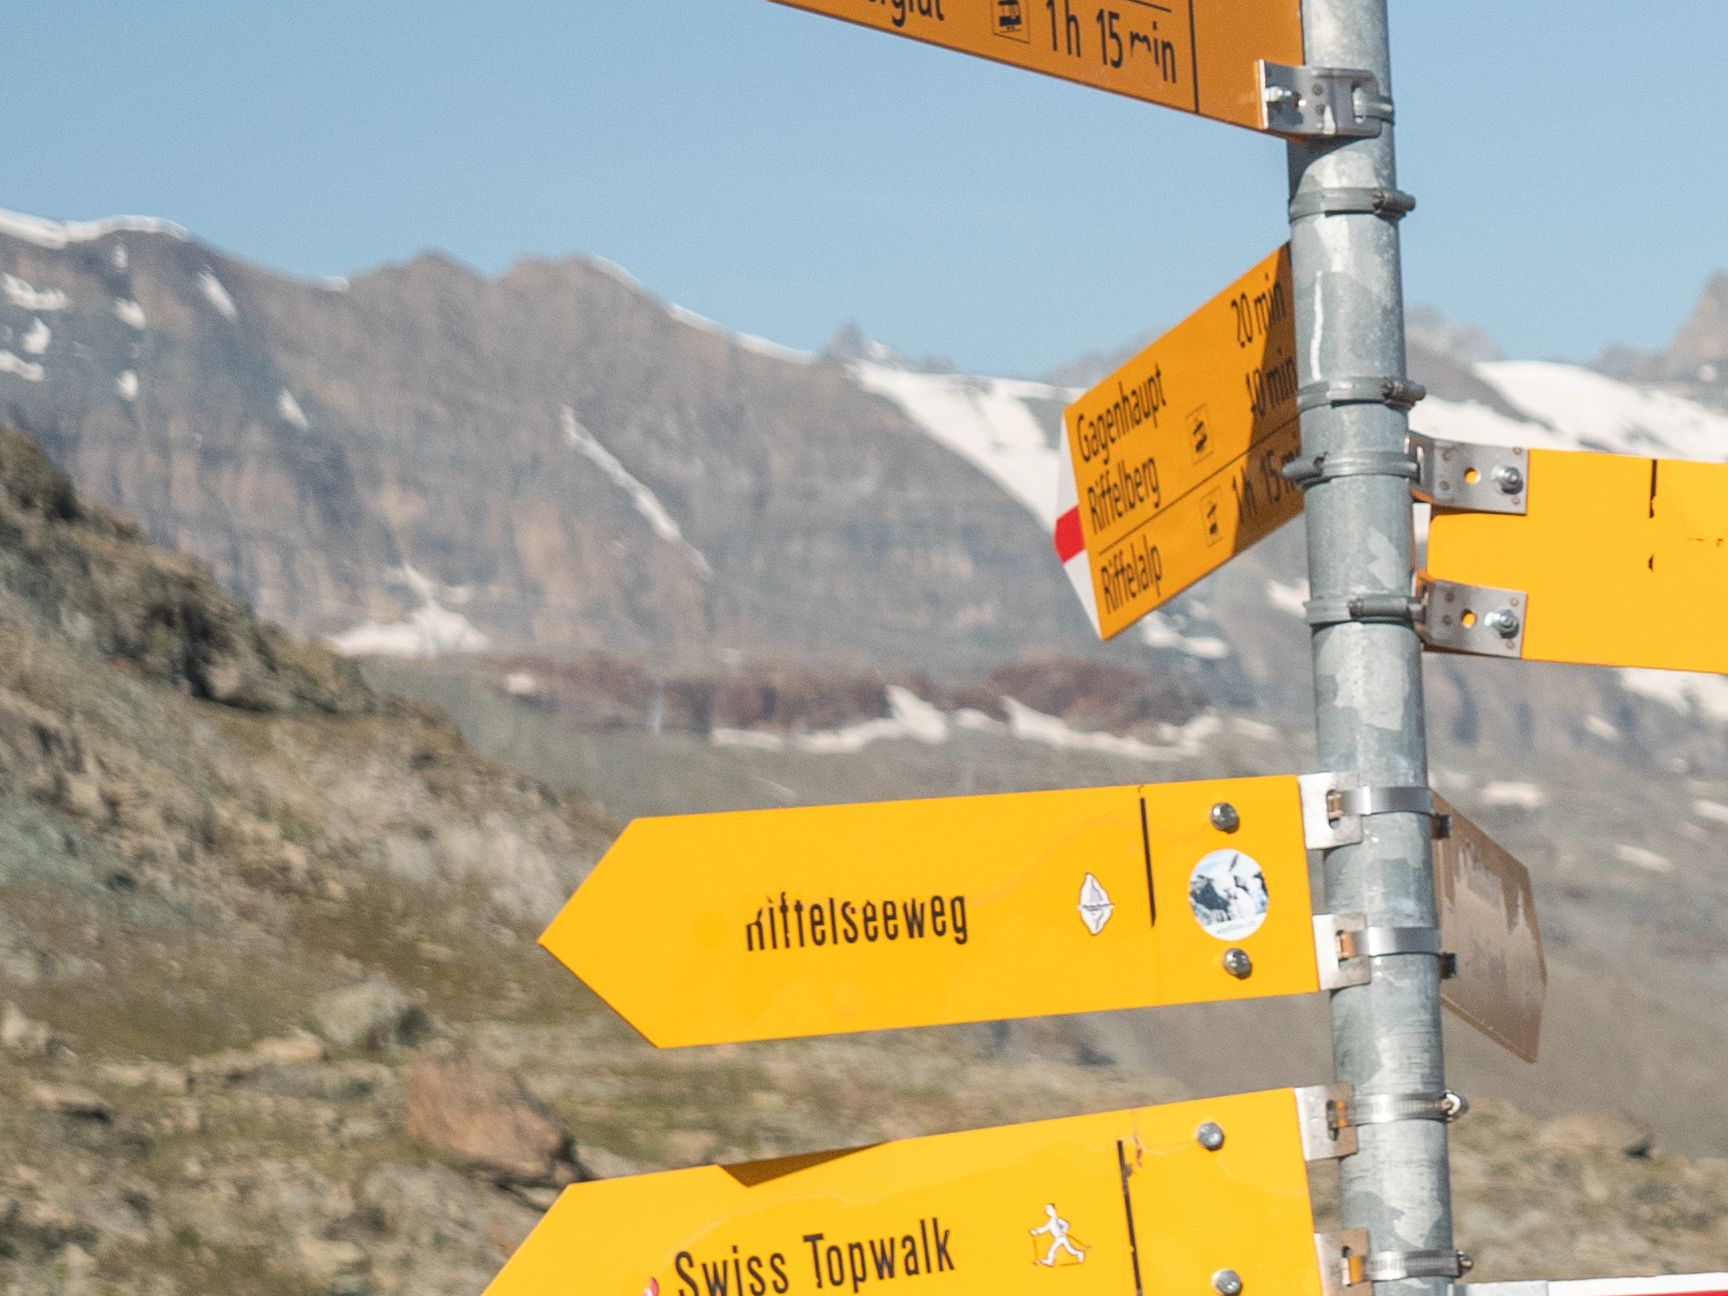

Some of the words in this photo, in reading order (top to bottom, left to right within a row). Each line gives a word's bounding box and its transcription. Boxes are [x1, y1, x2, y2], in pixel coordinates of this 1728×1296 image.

[1096, 7, 1124, 70] 15
[1230, 290, 1254, 349] 20
[1076, 362, 1168, 465] Gagenhaupt
[1087, 456, 1162, 536] Riffelberg
[1100, 533, 1163, 616] Riffelalp
[802, 1216, 957, 1294] Topwalk
